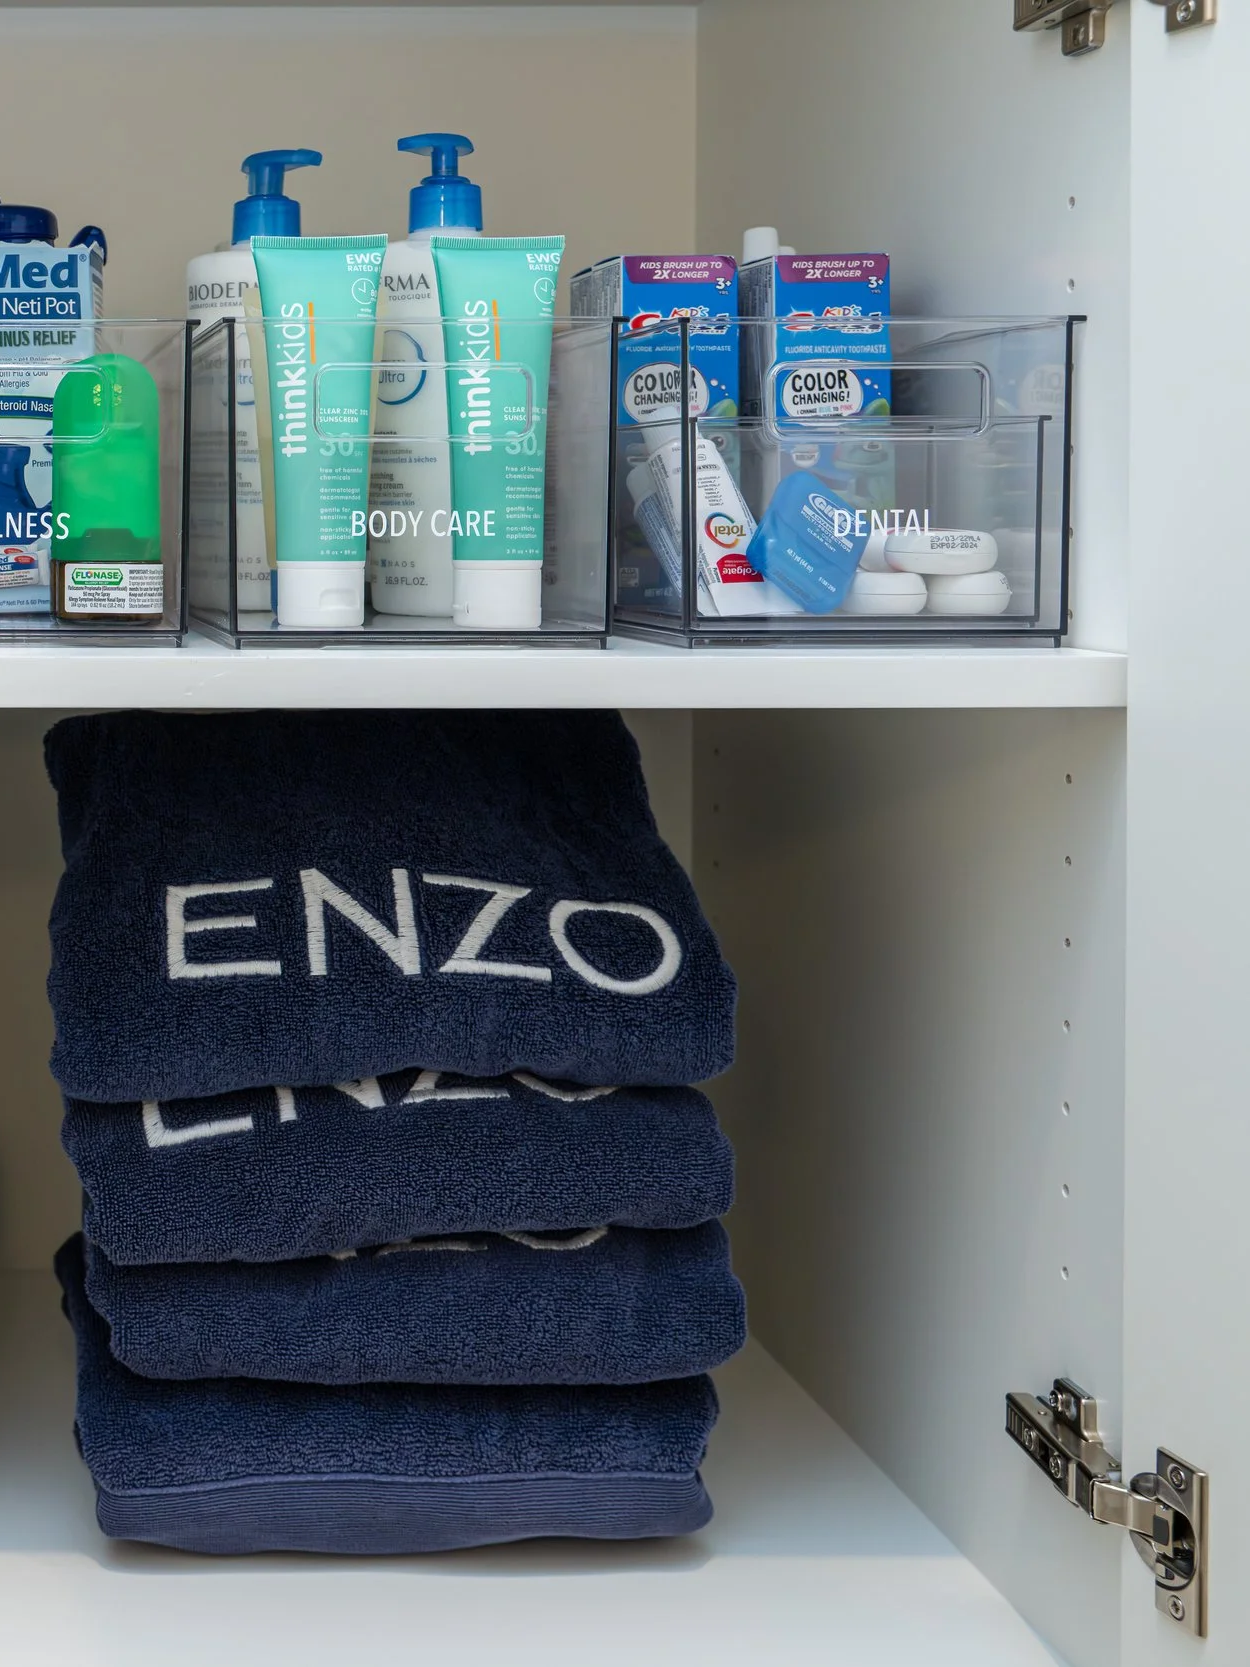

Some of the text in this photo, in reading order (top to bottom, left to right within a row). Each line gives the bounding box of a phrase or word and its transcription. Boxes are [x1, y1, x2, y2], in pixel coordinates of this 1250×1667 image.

[346, 252, 382, 265] EWG
[526, 252, 561, 265] EWG
[639, 261, 723, 270] KIDS BRUSH UP TO
[792, 260, 875, 269] KIDS BRUSH UP TO
[347, 264, 373, 272] RATED
[528, 263, 554, 272] RATED
[652, 269, 710, 280] 2X LONGER
[805, 269, 862, 279] 2X LONGER
[378, 273, 431, 292] RMA
[715, 277, 733, 290] 3+
[868, 276, 885, 289] 3+
[188, 281, 259, 302] BIODER
[2, 297, 41, 316] Neti
[46, 296, 76, 315] Pot
[670, 304, 710, 318] KID'S
[823, 303, 862, 317] KID'S
[33, 329, 76, 346] RELIEF
[785, 344, 887, 354] FLUORIDE ANTICAVITY TOOTHPASTE
[0, 379, 30, 390] Allergies
[274, 302, 307, 458] thinkkids
[457, 300, 493, 456] thinkkids
[791, 369, 850, 393] COLOR
[792, 391, 851, 406] CHANGING!
[319, 407, 341, 415] CLEAR
[505, 430, 538, 456] 30
[413, 455, 437, 463] sèches
[350, 508, 497, 538] BODY CARE
[833, 509, 936, 537] DENTAL
[714, 524, 747, 538] Total
[165, 867, 684, 996] ENZO
